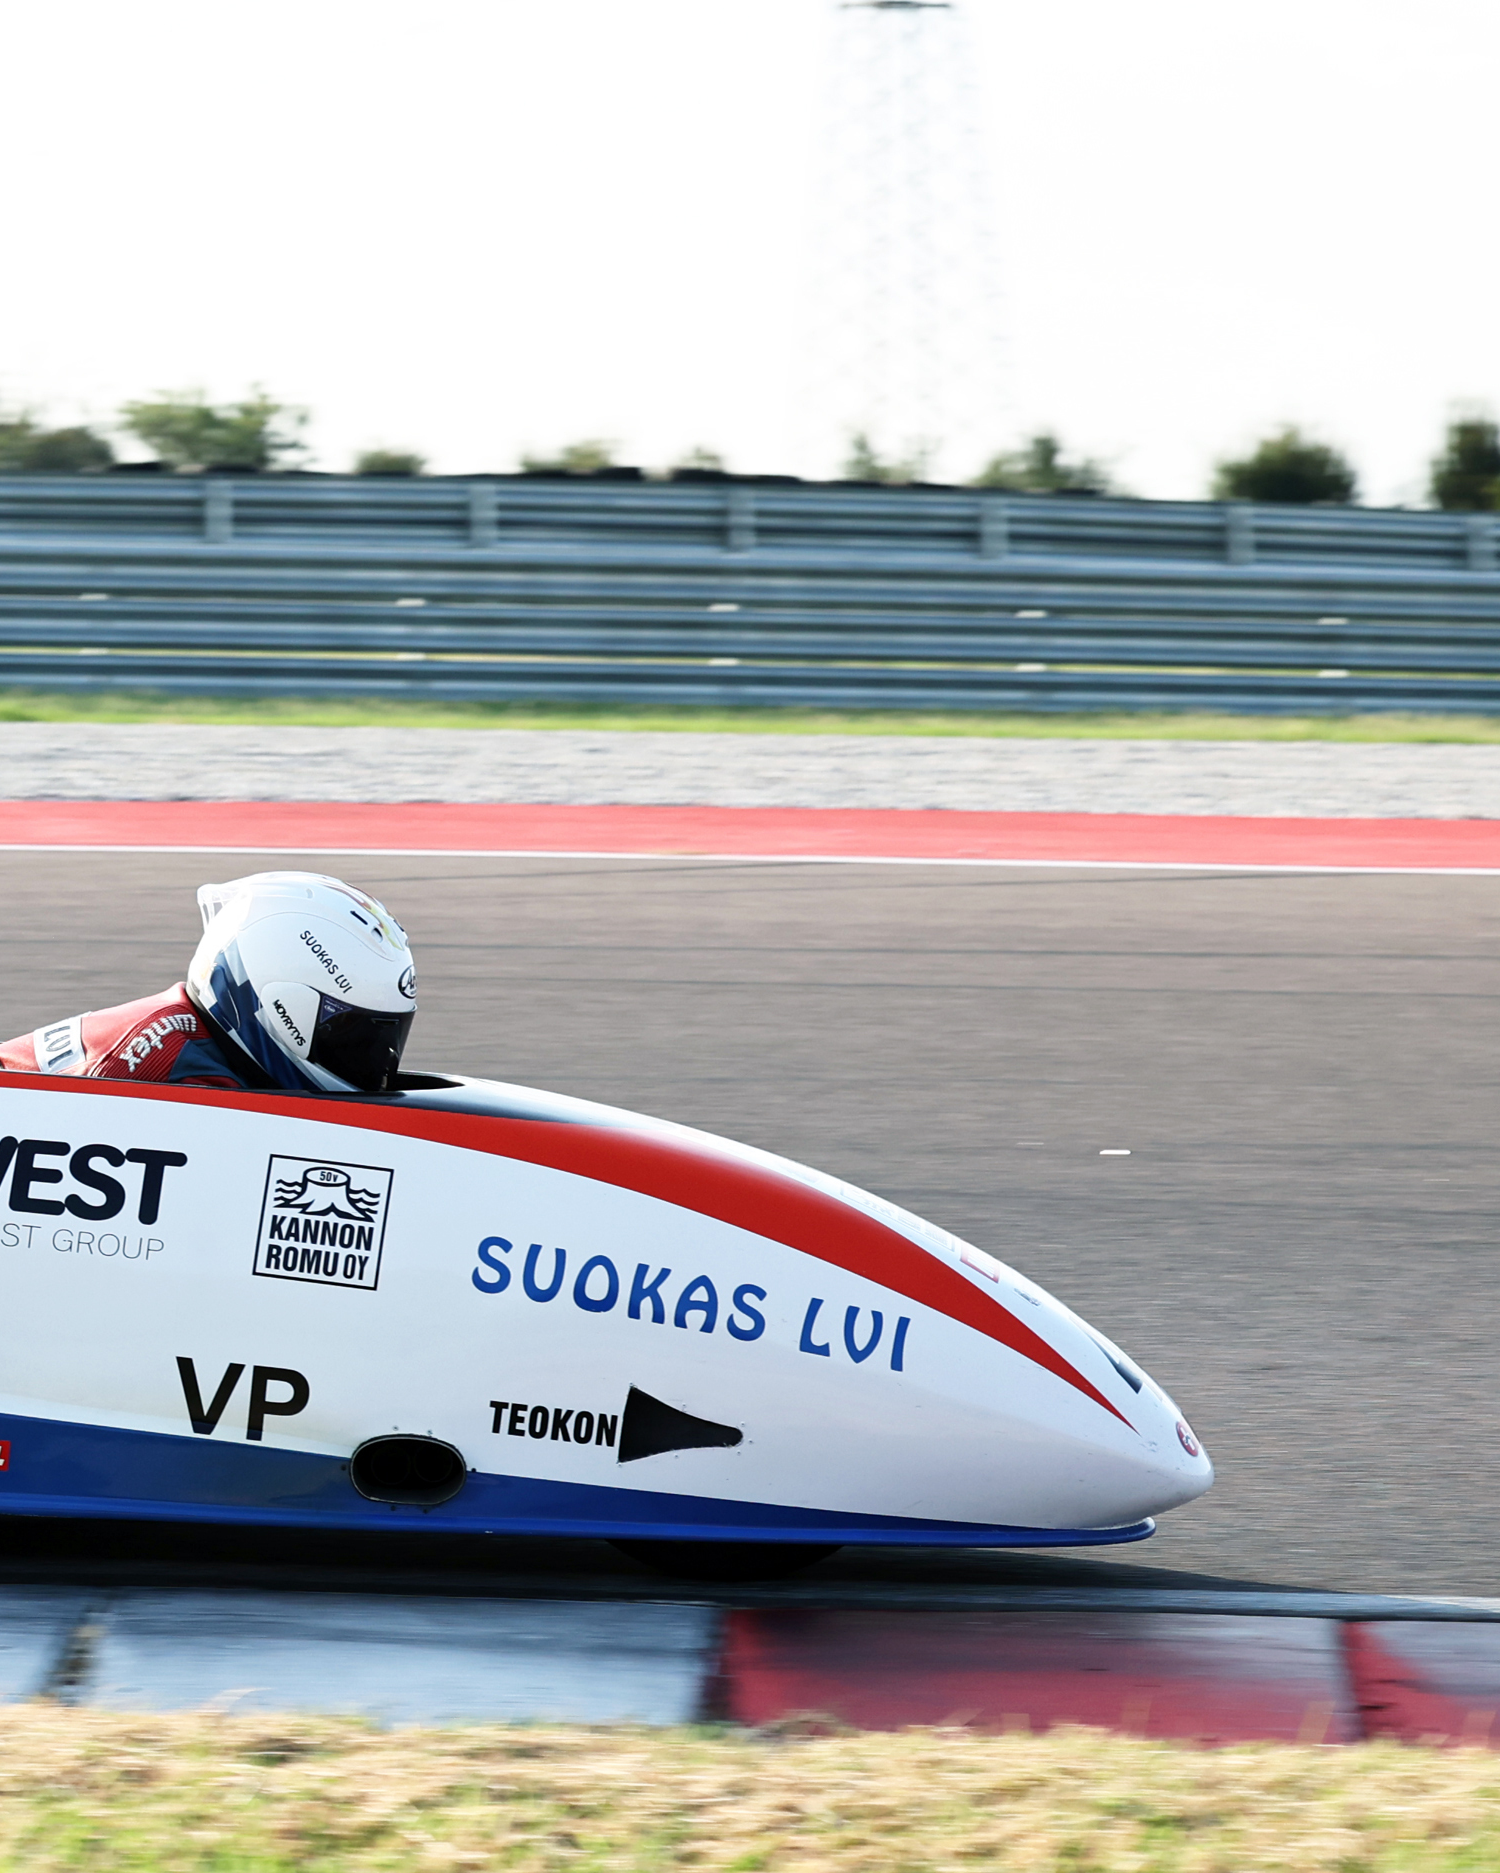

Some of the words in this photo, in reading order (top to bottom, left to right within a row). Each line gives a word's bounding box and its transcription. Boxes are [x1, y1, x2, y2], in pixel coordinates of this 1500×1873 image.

[299, 930, 339, 975] SUOKAS
[334, 974, 353, 994] LVI
[44, 1025, 74, 1067] LVI
[119, 1013, 197, 1073] wintex
[52, 1228, 165, 1261] GROUP
[269, 1214, 375, 1252] KANNON
[265, 1244, 340, 1277] ROMU
[342, 1253, 370, 1281] OY
[471, 1235, 768, 1342] SUOKAS
[799, 1297, 911, 1372] LVI
[175, 1356, 311, 1442] VP
[489, 1399, 619, 1448] TEOKON
